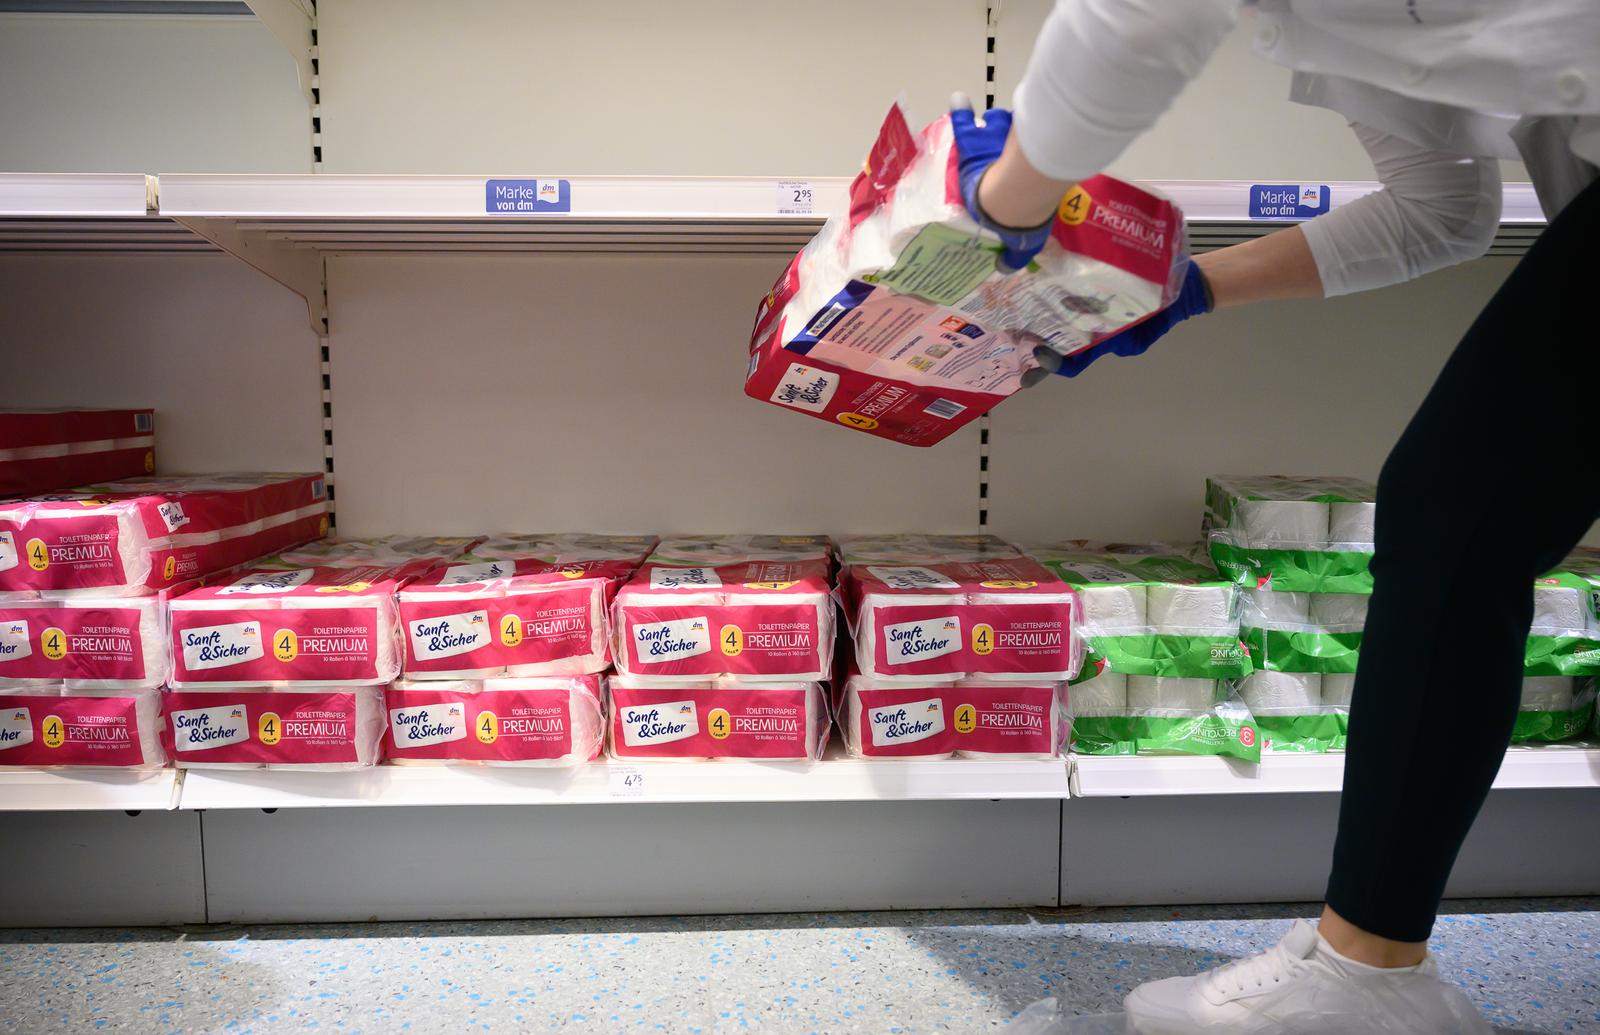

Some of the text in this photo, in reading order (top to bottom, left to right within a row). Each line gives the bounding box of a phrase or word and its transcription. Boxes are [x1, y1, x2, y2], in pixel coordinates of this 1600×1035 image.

[496, 186, 533, 199] Marke
[542, 183, 555, 191] dm
[497, 200, 533, 210] von dm
[1067, 194, 1082, 212] 4
[1260, 191, 1296, 204] Marke
[1260, 205, 1295, 215] von dm
[1093, 205, 1164, 248] PREMIUM
[778, 383, 801, 404] Sanft
[860, 386, 908, 417] PREMIUM
[847, 416, 866, 425] 4
[33, 545, 43, 561] 4
[81, 626, 130, 635] TOILETTENPAPIER
[313, 627, 368, 635] TOILETTENPAPIER
[416, 621, 450, 639] Sanft
[505, 621, 516, 638] 4
[692, 621, 703, 629] dm
[1010, 621, 1062, 630] TOILETTENPAPIER
[47, 634, 60, 650] 4
[186, 630, 220, 648] Sanft
[428, 632, 479, 652] &Sicher
[638, 626, 671, 643] Sanft
[725, 631, 737, 647] 4
[748, 634, 810, 648] PREMIUM
[889, 626, 923, 642] Sanft
[977, 630, 989, 646] 4
[999, 633, 1061, 646] PREMIUM
[72, 638, 132, 651] PREMIUM
[199, 644, 250, 661] &Sicher
[279, 636, 291, 653] 4
[303, 638, 368, 652] PREMIUM
[650, 638, 698, 655] &Sicher
[901, 638, 949, 656] &Sicher
[511, 707, 561, 716] TOILETTENPAPIER
[992, 703, 1043, 712] TOILETTENPAPIER
[176, 713, 210, 730] Sanft
[396, 710, 429, 726] Sanft
[626, 709, 659, 725] Sanft
[713, 715, 725, 731] 4
[736, 718, 797, 732] PREMIUM
[874, 709, 906, 725] Sanft
[959, 710, 970, 725] 4
[981, 714, 1043, 728] PREMIUM
[47, 723, 59, 738] 4
[263, 719, 275, 735] 4
[286, 723, 347, 736] PREMIUM
[408, 723, 455, 740] &Sicher
[481, 718, 492, 734] 4
[503, 718, 563, 733] PREMIUM
[638, 722, 687, 738] &Sicher
[885, 720, 934, 738] &Sicher
[69, 727, 129, 741] PREMIUM
[189, 727, 237, 743] &Sicher
[1244, 730, 1251, 743] 3
